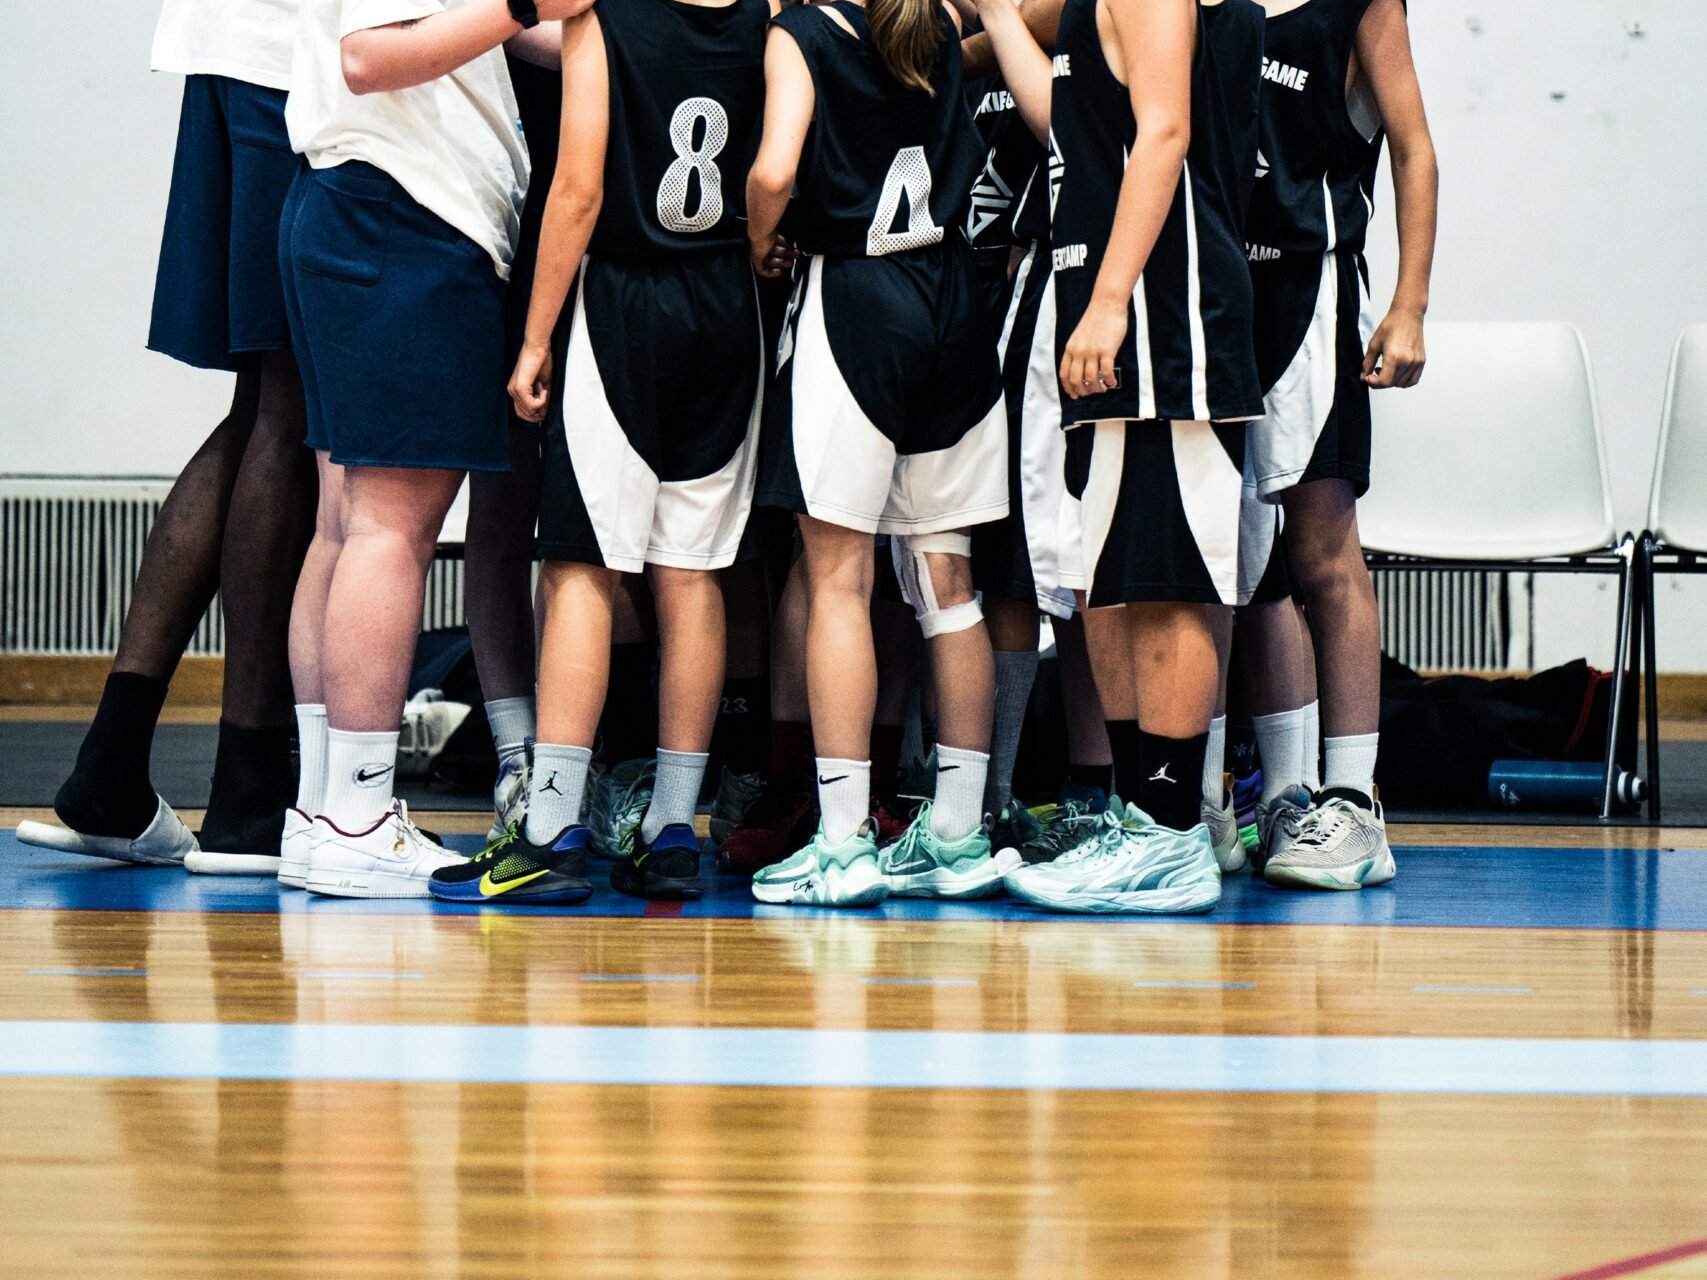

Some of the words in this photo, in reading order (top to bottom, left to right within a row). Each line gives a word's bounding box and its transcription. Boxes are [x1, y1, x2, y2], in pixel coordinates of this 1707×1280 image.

[656, 97, 728, 232] 8
[866, 145, 944, 256] 4
[721, 697, 748, 713] 23
